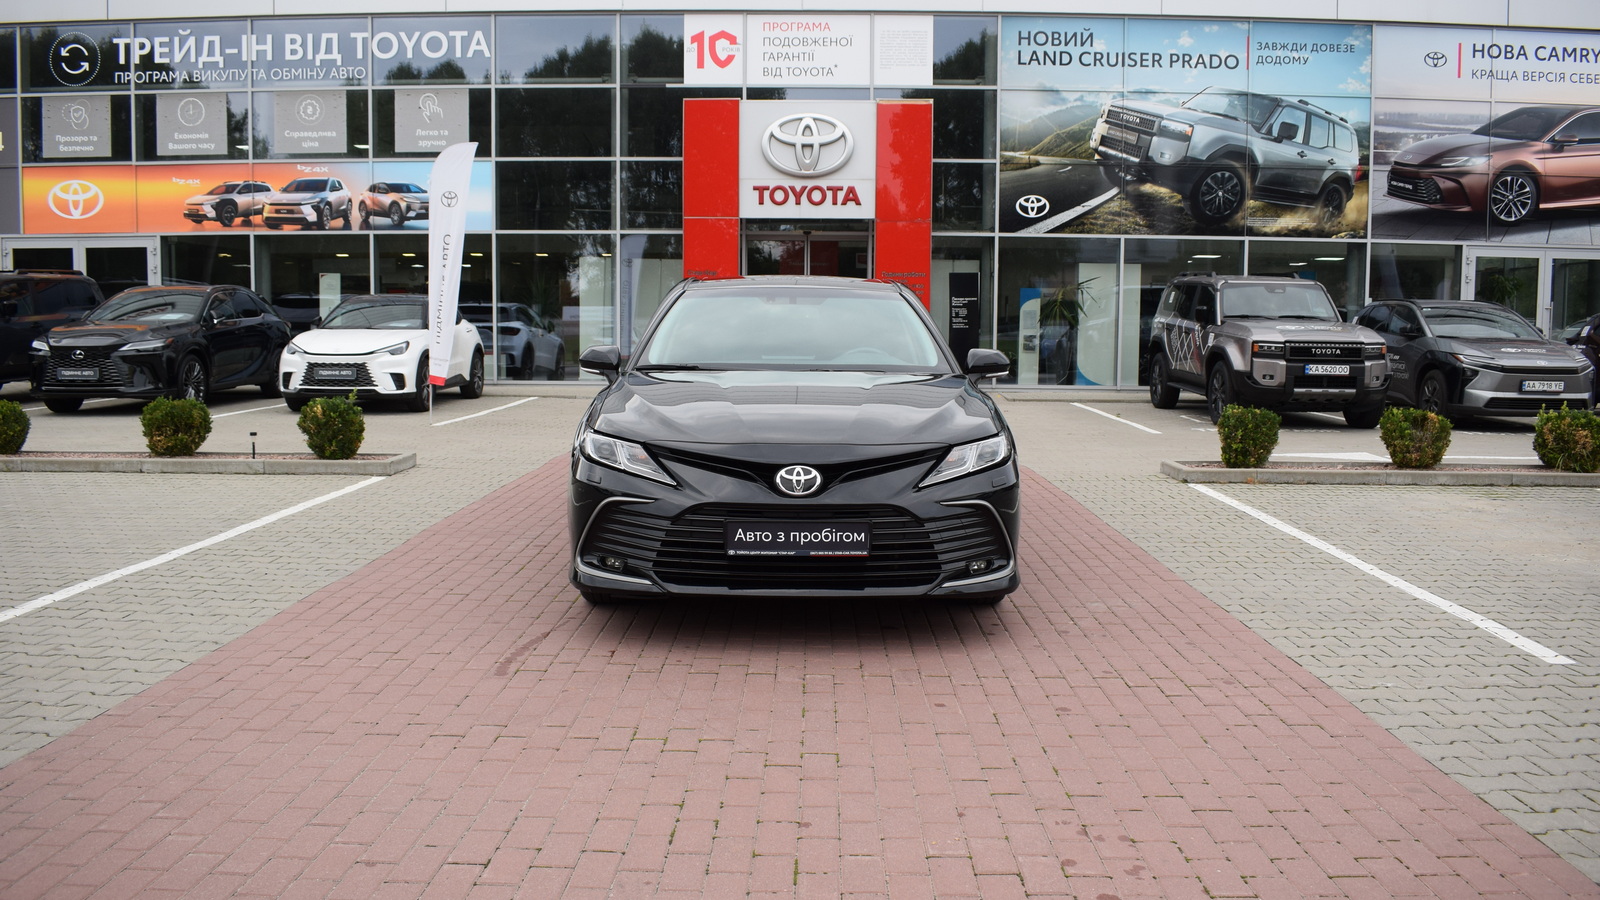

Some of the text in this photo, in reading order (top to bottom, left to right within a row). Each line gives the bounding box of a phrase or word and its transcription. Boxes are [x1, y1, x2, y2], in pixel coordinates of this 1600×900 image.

[762, 22, 831, 32] ПРОГРАМА
[762, 35, 853, 48] ПОДОВЖЕНОЇ
[1017, 28, 1094, 47] НОВИЙ
[112, 29, 491, 68] ТРЕЙД-ІН ВІД TOYOTA
[1256, 41, 1356, 54] ЗАВЖДИ ДОВЕЗЕ
[1471, 43, 1600, 63] НОВА CAMRY
[762, 50, 815, 61] ГАРАНТІЇ
[1017, 50, 1240, 70] LAND CRUISER PRADO
[1256, 54, 1310, 66] ДОДОМУ
[114, 66, 366, 84] ПРОГРАМА ВИКУПУ ТА ОБМІНУ АВТО
[762, 67, 782, 78] ВІД
[1471, 69, 1600, 84] КРАЩА ВЕРСІЯ СЕБЕ
[1120, 113, 1140, 123] TOYOTA
[174, 132, 209, 140] Економія
[284, 130, 337, 139] Справедлива
[415, 129, 438, 137] Легко
[55, 134, 88, 144] Прозоро
[302, 140, 319, 148] ціна
[418, 140, 447, 148] зручно
[59, 144, 94, 152] безпечно
[168, 142, 216, 151] Вашого часу
[753, 185, 862, 206] TOYOTA
[1309, 365, 1320, 373] KA
[1320, 365, 1337, 373] 5620
[734, 528, 865, 545] Авто з пробігом
